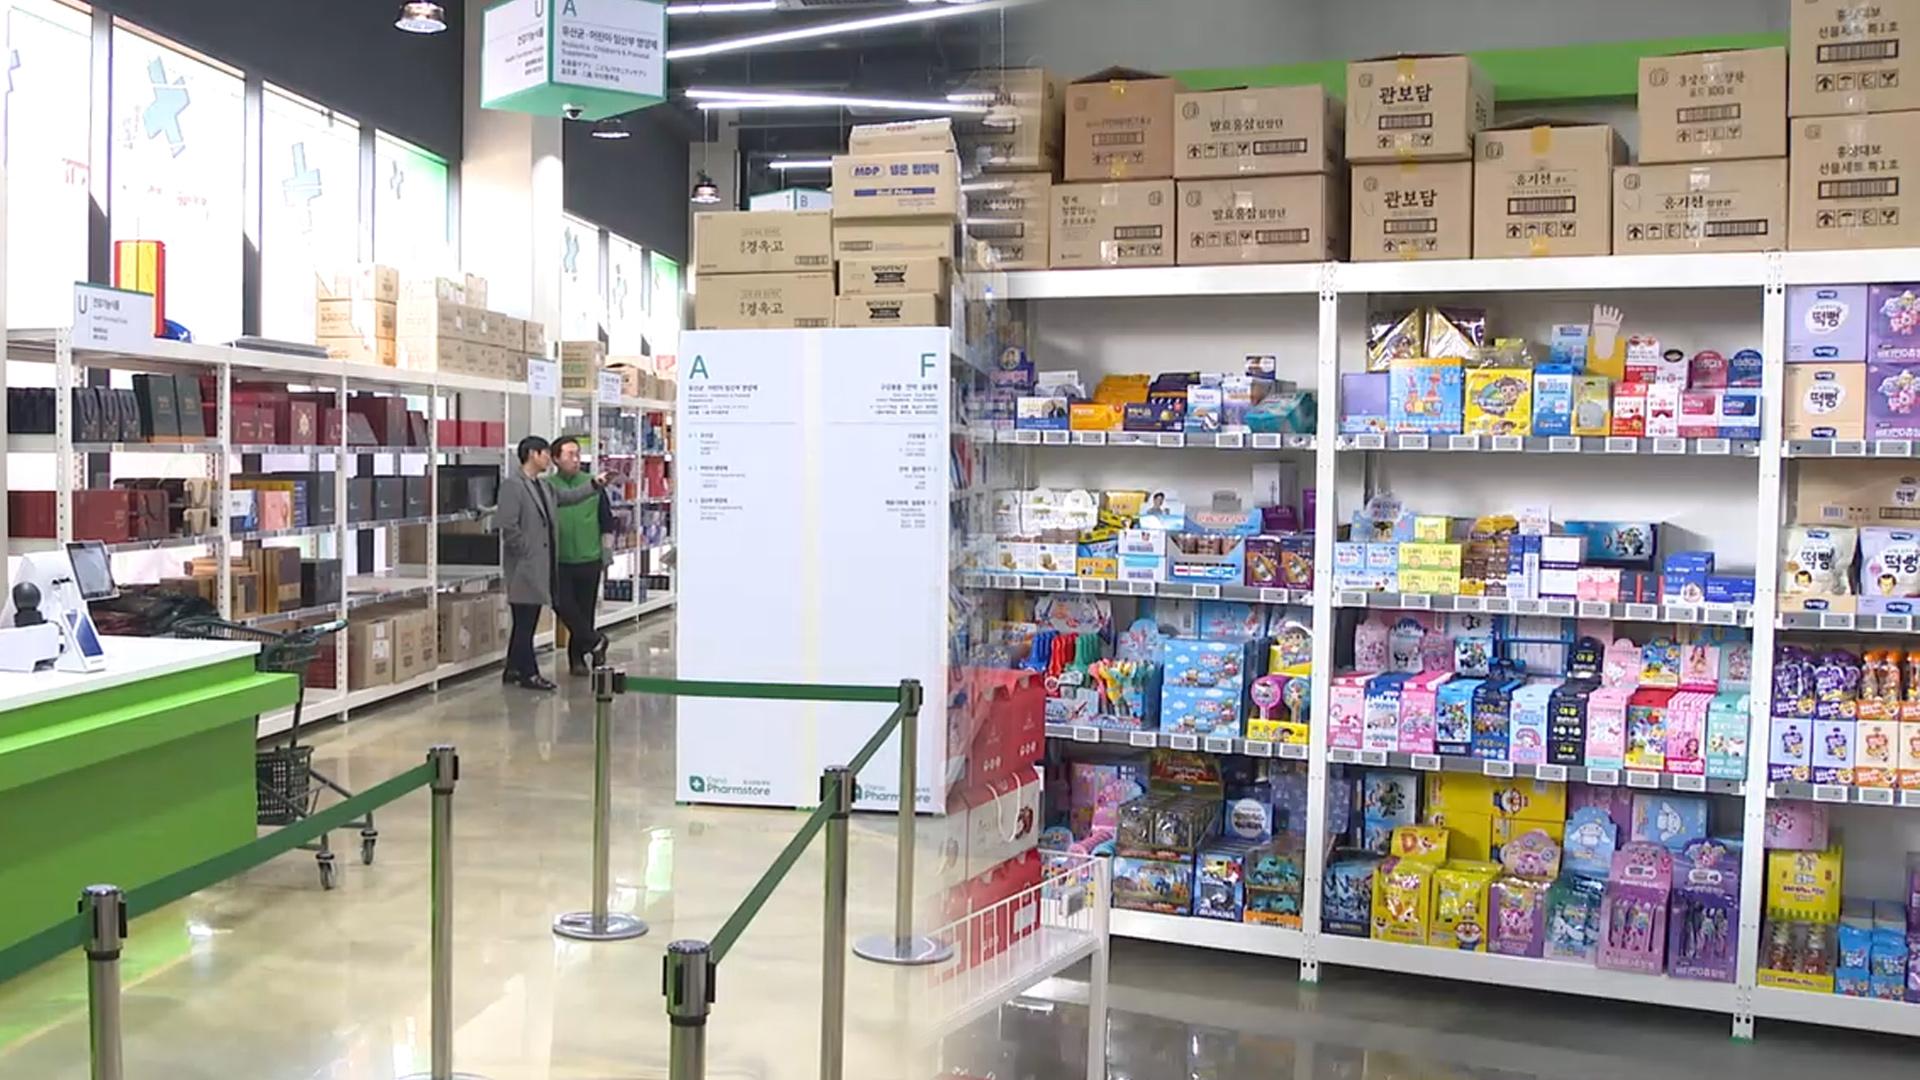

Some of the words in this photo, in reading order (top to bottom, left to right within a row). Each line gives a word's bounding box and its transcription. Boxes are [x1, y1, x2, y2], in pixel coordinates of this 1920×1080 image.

[562, 0, 577, 17] A
[562, 25, 584, 39] 유산균
[613, 33, 635, 47] 임산부
[1379, 84, 1433, 104] 관보담
[1819, 161, 1864, 176] 선물세트
[1384, 189, 1438, 209] 관보담
[746, 240, 784, 254] 경옥고
[78, 294, 88, 315] U
[746, 302, 784, 316] 경옥고
[689, 355, 709, 379] A
[920, 353, 936, 378] F
[707, 783, 770, 796] Pharmstore
